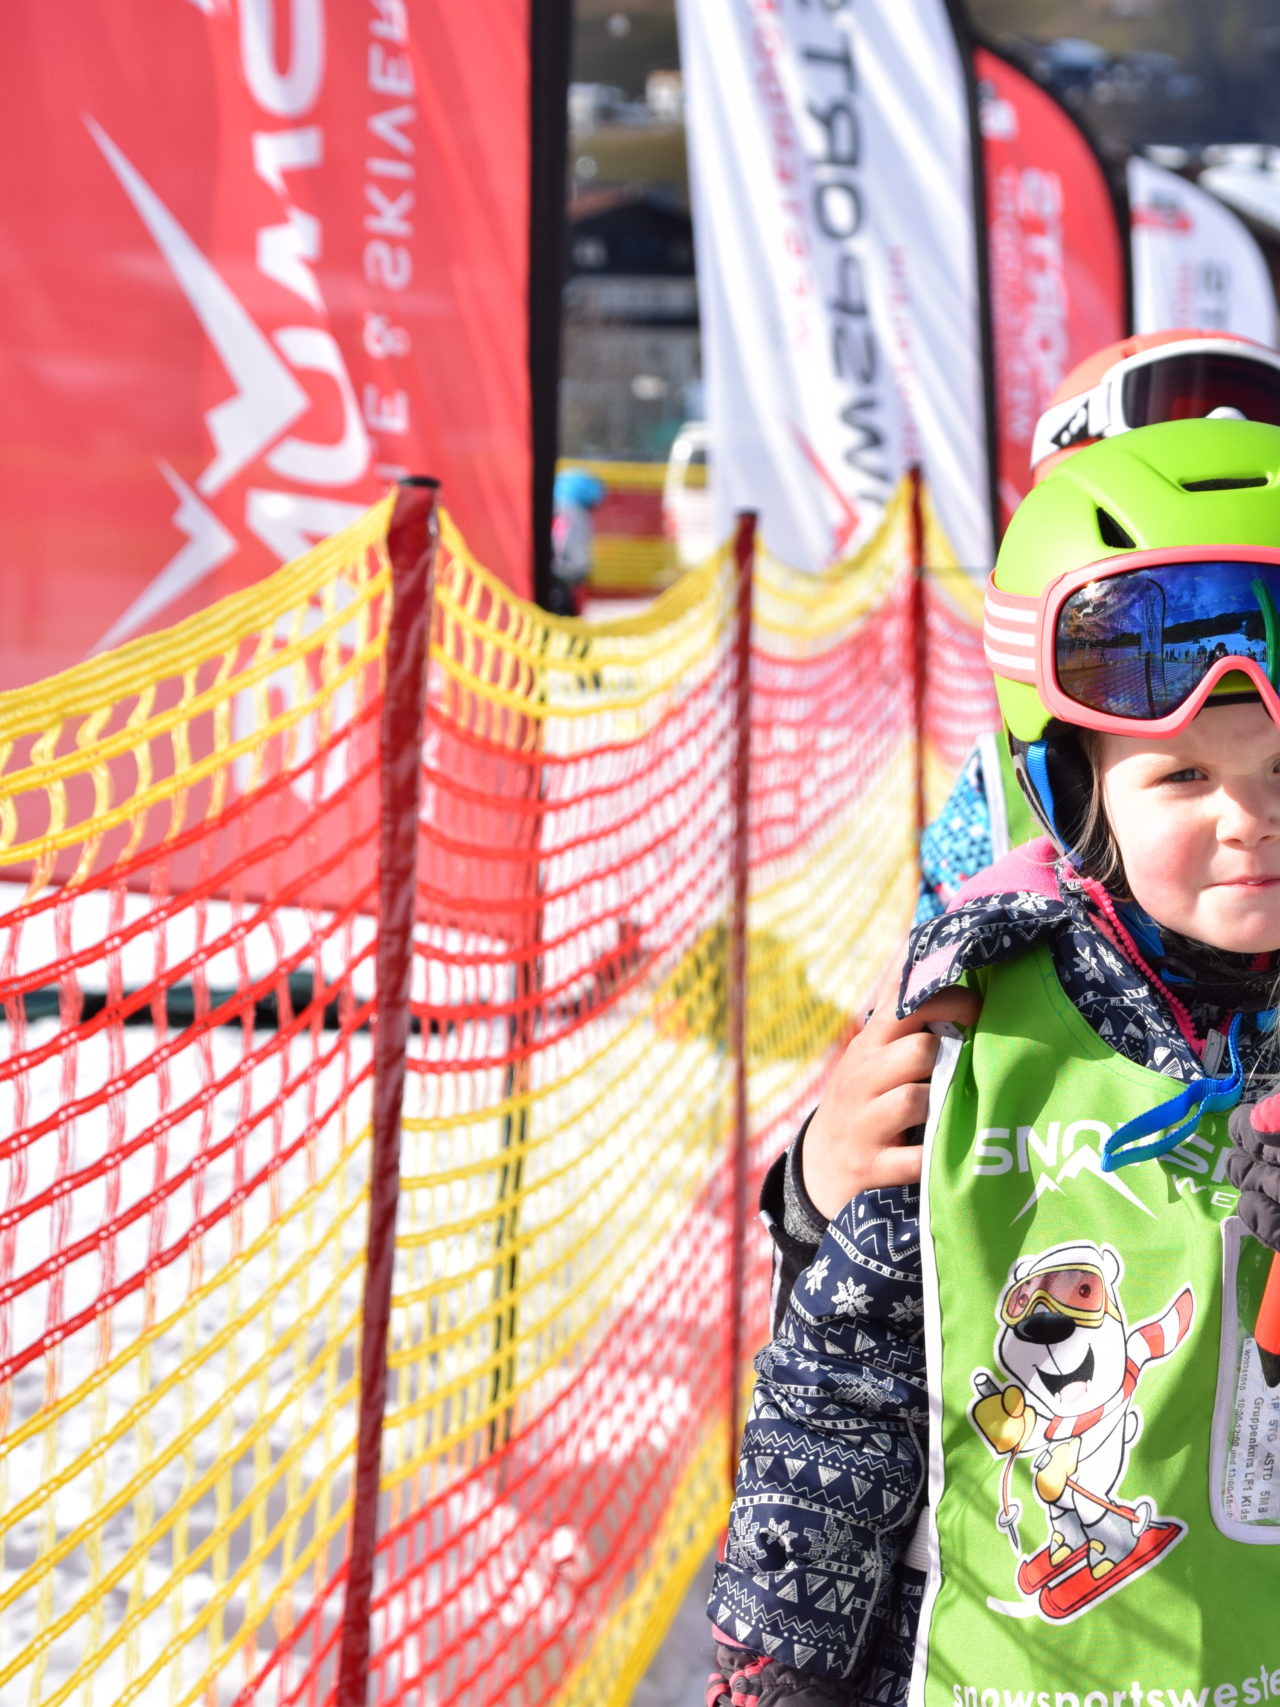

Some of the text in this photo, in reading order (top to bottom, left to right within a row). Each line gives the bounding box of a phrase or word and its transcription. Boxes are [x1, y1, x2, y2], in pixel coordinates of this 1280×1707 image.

[1245, 1397, 1264, 1469] Gruppenkurs
[1262, 1452, 1274, 1481] 4STD
[1240, 1495, 1252, 1521] Kids
